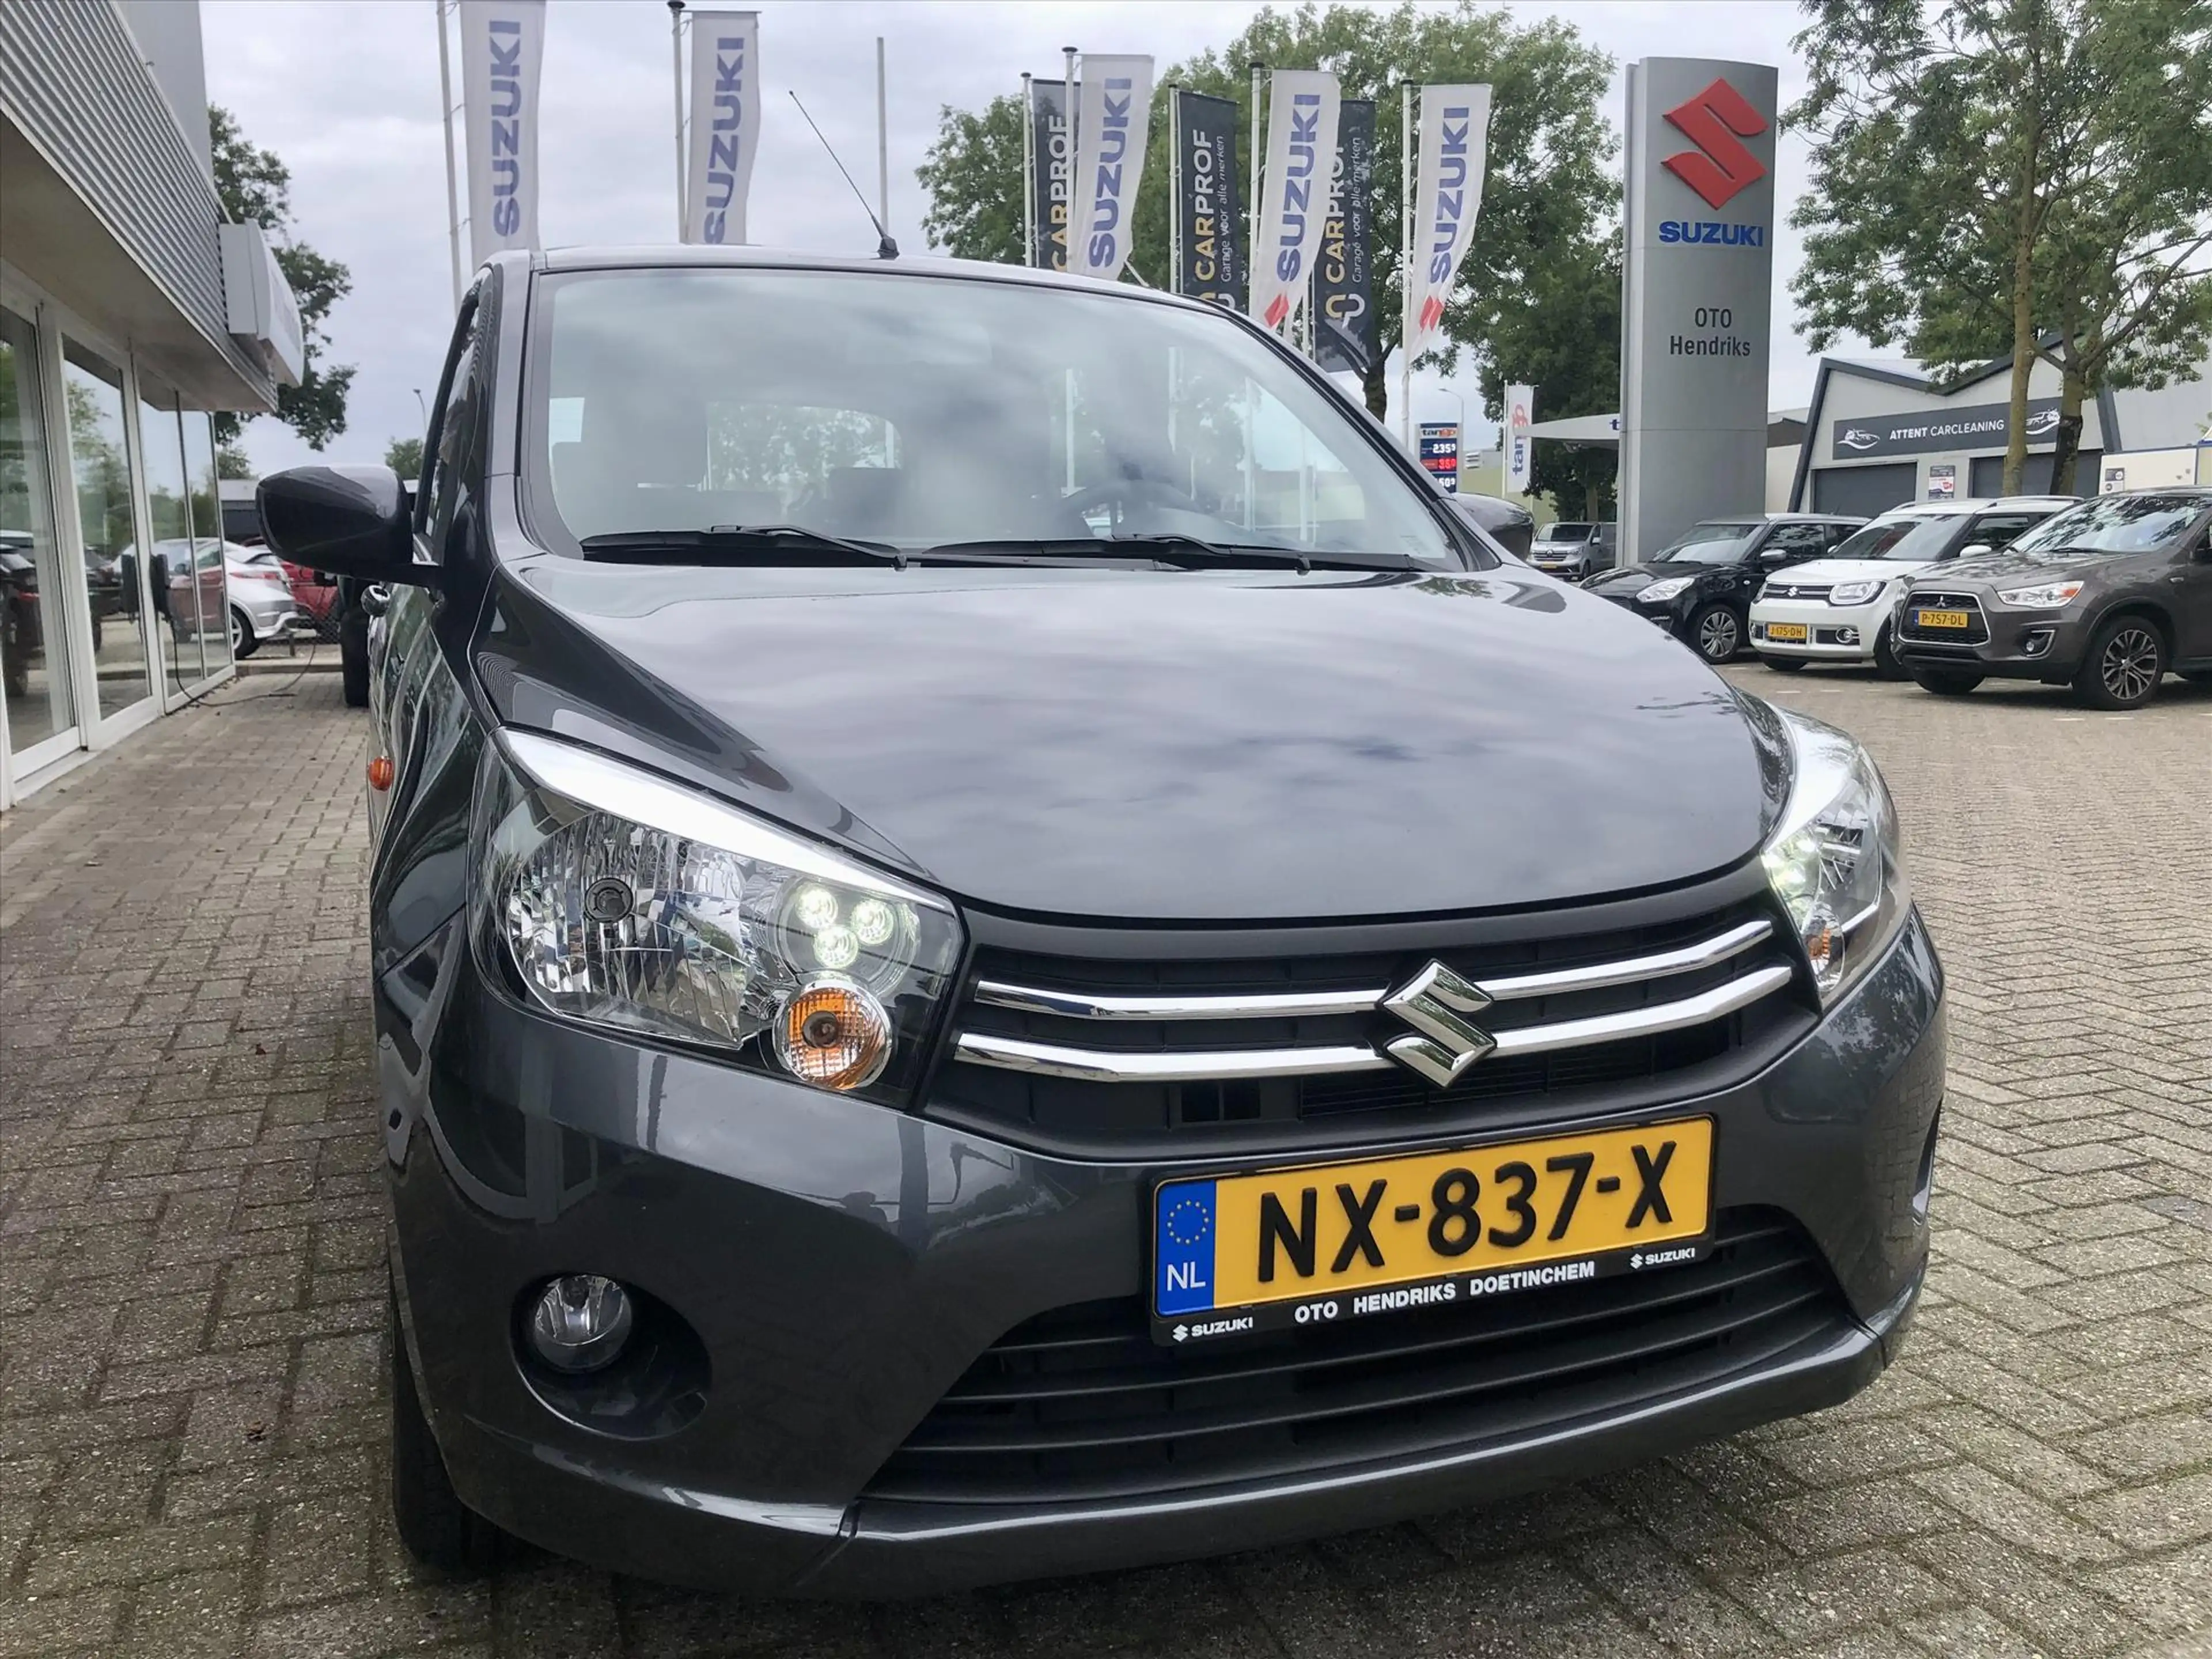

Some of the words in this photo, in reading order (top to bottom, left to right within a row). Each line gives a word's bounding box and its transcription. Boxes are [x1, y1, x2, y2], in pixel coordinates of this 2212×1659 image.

[489, 20, 521, 237] SUZUKI
[704, 37, 745, 244] SUZUKI
[1049, 115, 1067, 272] CARPROF
[1089, 78, 1132, 268] SUZUKI
[1277, 94, 1320, 282] SUZUKI
[1430, 107, 1469, 284] SUZUKI
[1192, 128, 1215, 281] CARPROF
[1326, 147, 1345, 281] CARPRO
[1352, 211, 1361, 237] voor
[1659, 221, 1763, 247] SUZUKI
[1671, 335, 1751, 357] Hendriks
[1695, 308, 1732, 328] OTO
[1889, 427, 1928, 440] ATTENT
[1930, 419, 2005, 437] CARCLEANING
[1922, 613, 1964, 626] P-757-DL
[1257, 1141, 1677, 1283] NX-837-X
[1166, 1262, 1206, 1291] NL
[1645, 1247, 1696, 1266] SUZUKI
[1294, 1301, 1339, 1323] OTO
[1353, 1282, 1456, 1315] HENDRIKS
[1470, 1261, 1595, 1296] DOETINCHEM
[1191, 1317, 1253, 1338] SUZUKI
